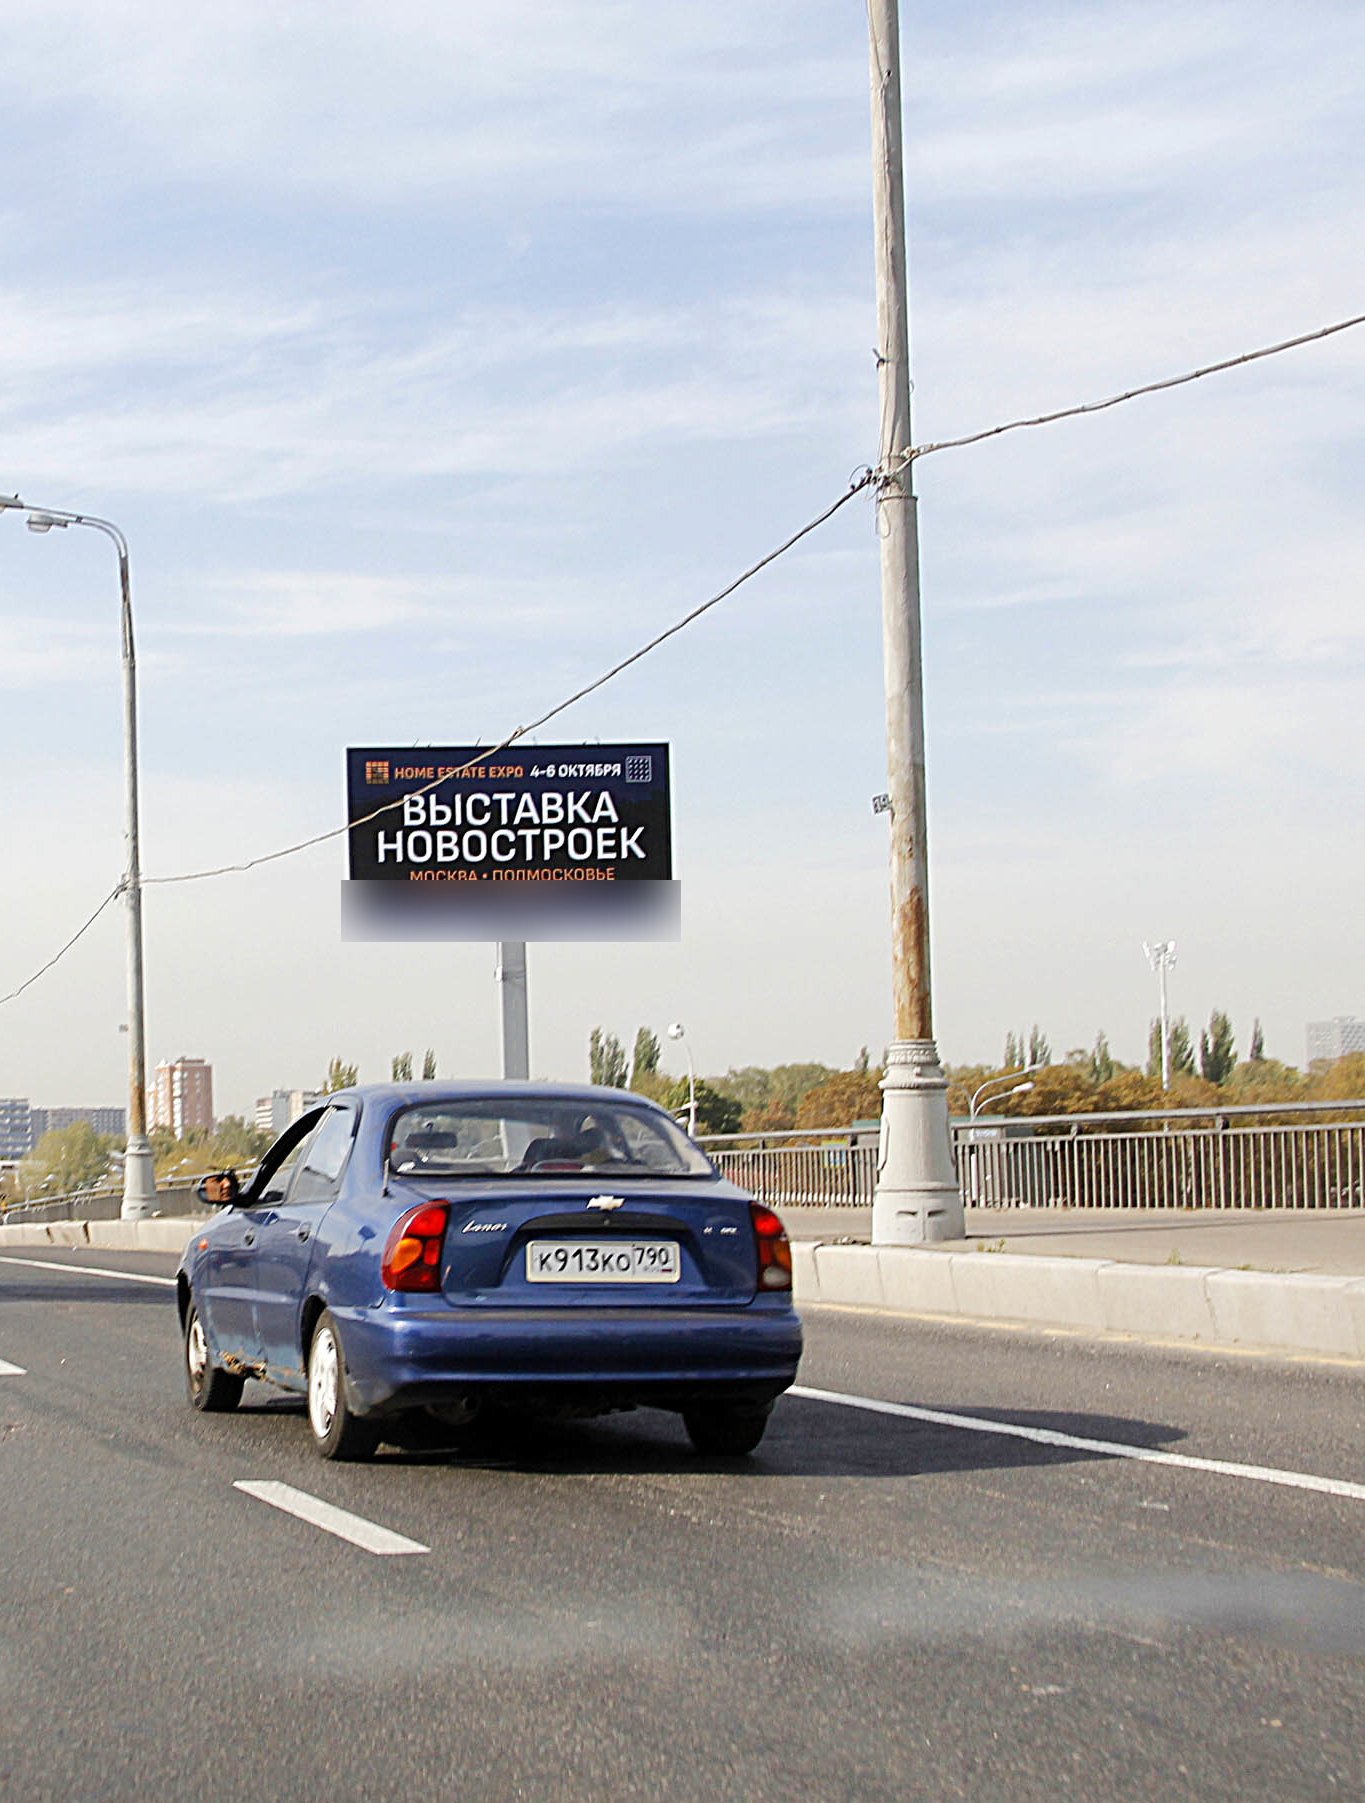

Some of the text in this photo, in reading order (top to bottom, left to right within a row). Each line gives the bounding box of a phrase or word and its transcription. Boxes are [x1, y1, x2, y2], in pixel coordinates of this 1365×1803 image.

[395, 766, 524, 779] HOME ESTATE EXPO
[558, 763, 622, 777] ОКТЯБРЯ
[403, 791, 619, 826] ВЫСТАВКА
[377, 827, 646, 863] НОВОСТРОЕК
